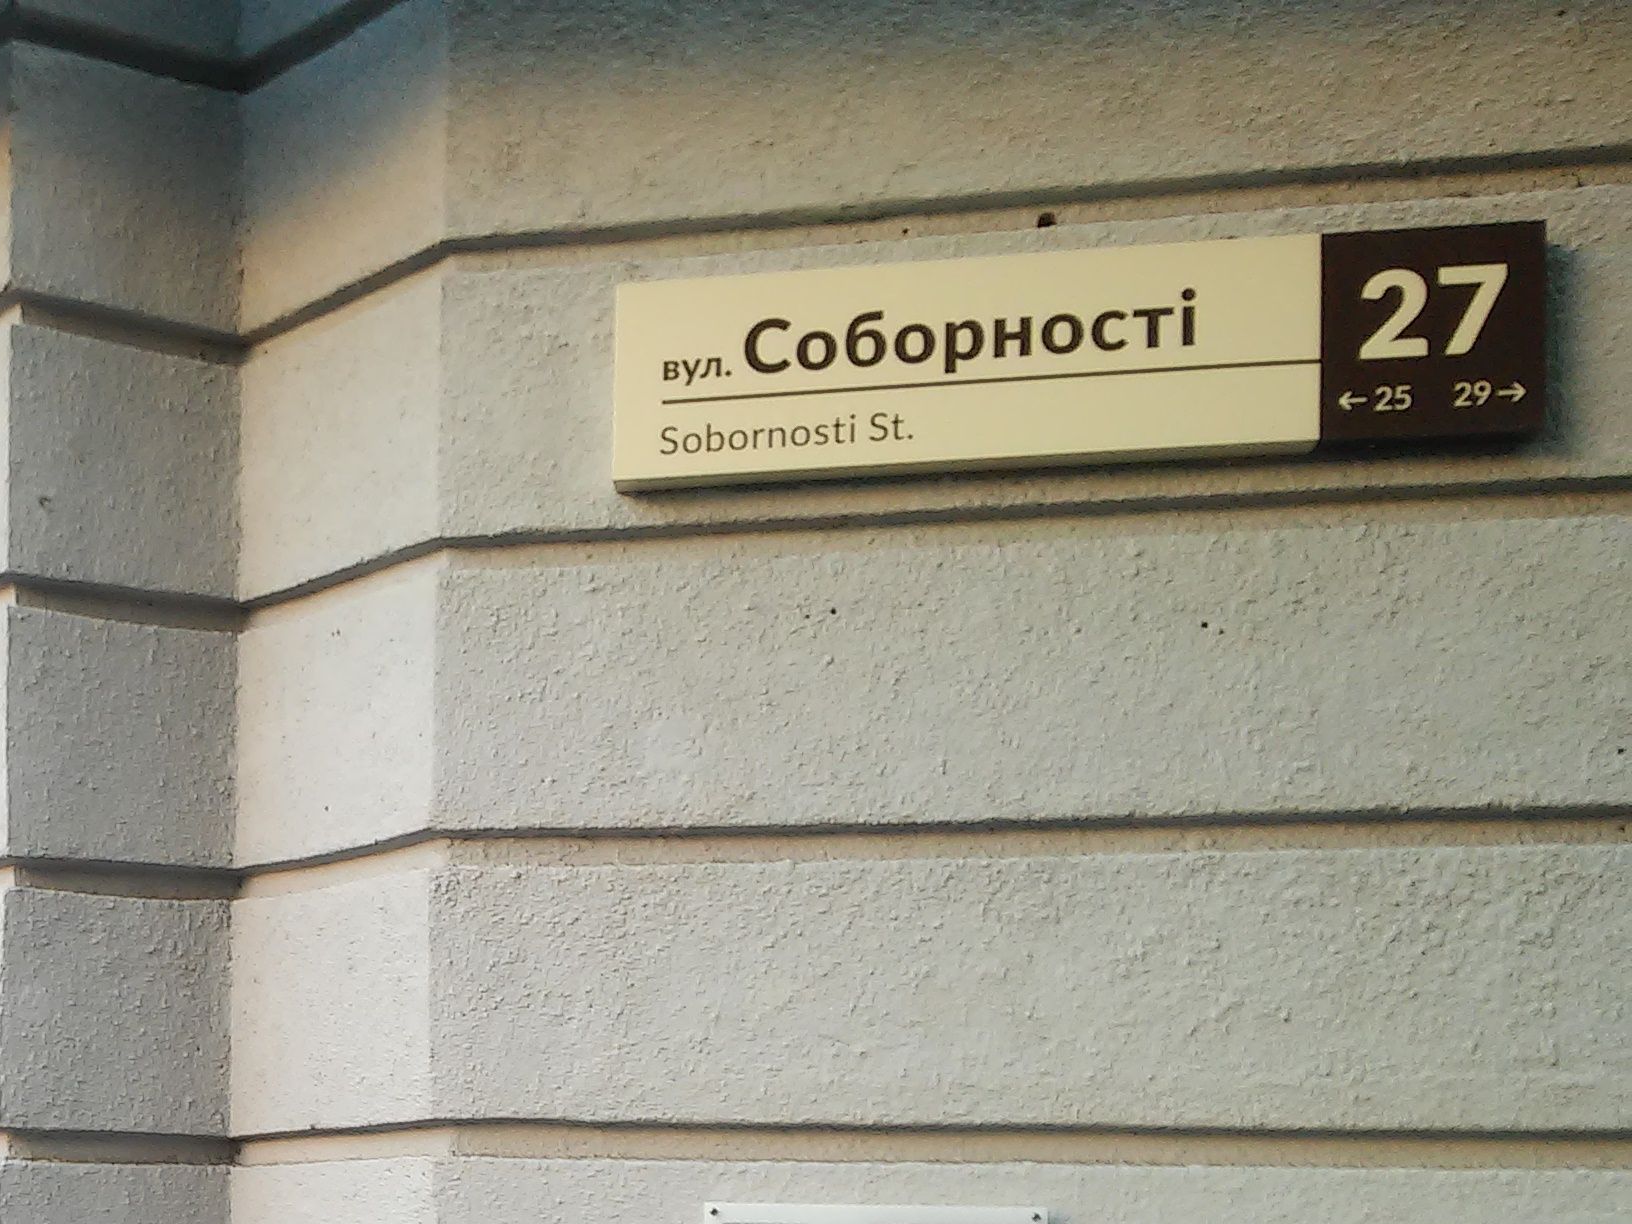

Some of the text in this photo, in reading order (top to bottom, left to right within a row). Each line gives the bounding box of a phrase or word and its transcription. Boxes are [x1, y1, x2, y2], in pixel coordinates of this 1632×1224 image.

[661, 287, 1197, 386] вул. Соборності
[1358, 262, 1510, 361] 27
[1372, 379, 1492, 412] 25 29
[658, 411, 915, 455] Sobornosti St.
